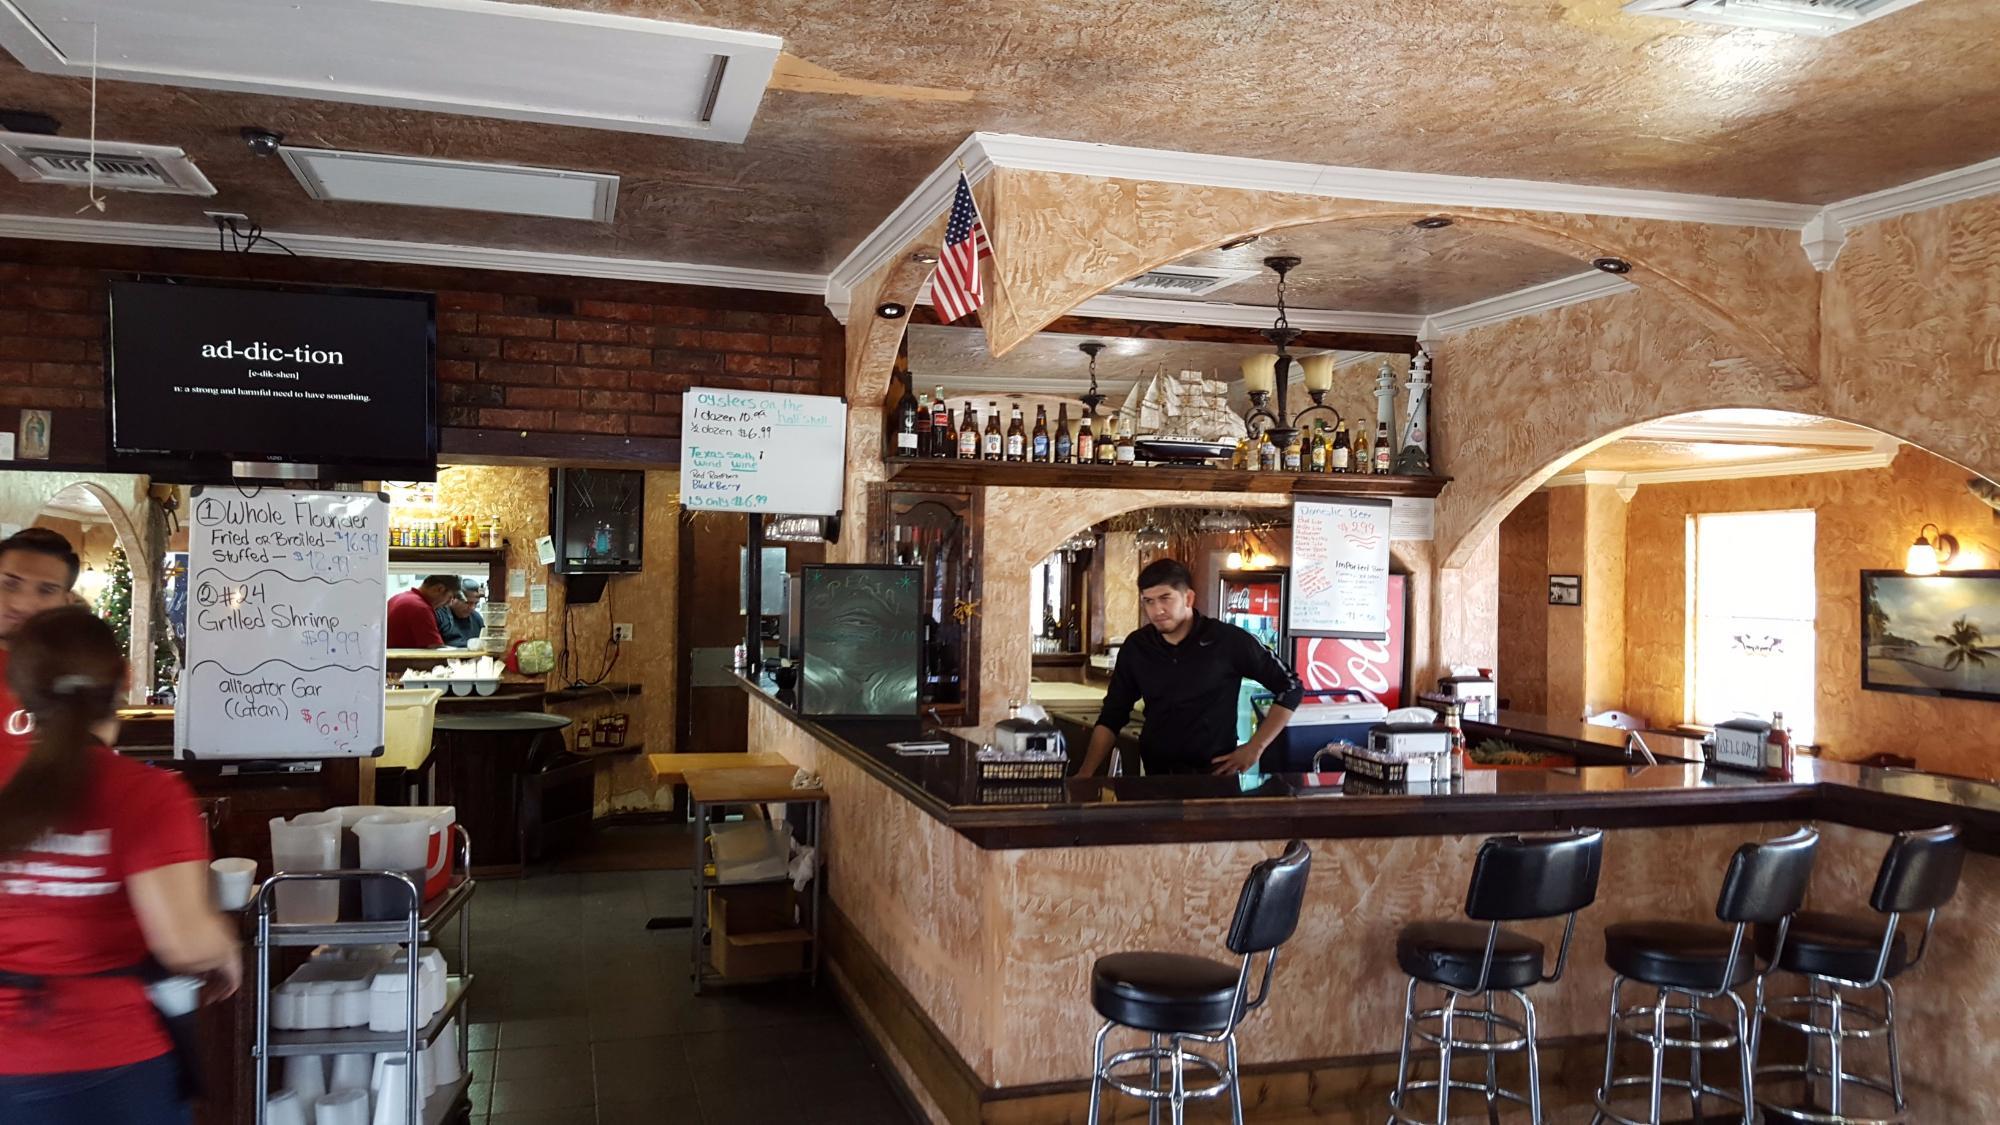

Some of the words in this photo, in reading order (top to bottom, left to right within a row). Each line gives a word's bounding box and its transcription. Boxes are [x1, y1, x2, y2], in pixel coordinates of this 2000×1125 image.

[202, 340, 344, 365] ad-dic-tion
[192, 386, 219, 395] strong
[220, 387, 236, 395] and
[237, 388, 272, 397] harmful
[273, 390, 294, 398] need
[305, 391, 325, 399] have
[326, 392, 371, 402] something.
[700, 410, 736, 422] dozen
[701, 424, 732, 437] dozen
[688, 446, 725, 459] Texas
[226, 500, 286, 525] Whole
[294, 502, 369, 529] Flounder
[211, 529, 249, 546] Fried
[212, 549, 269, 563] Stuffed
[198, 607, 265, 631] Grilled
[271, 604, 340, 632] Shrimp
[302, 630, 362, 655] $9.99
[219, 677, 286, 703] alligator
[292, 677, 322, 697] Gar
[300, 708, 360, 736] $6.99
